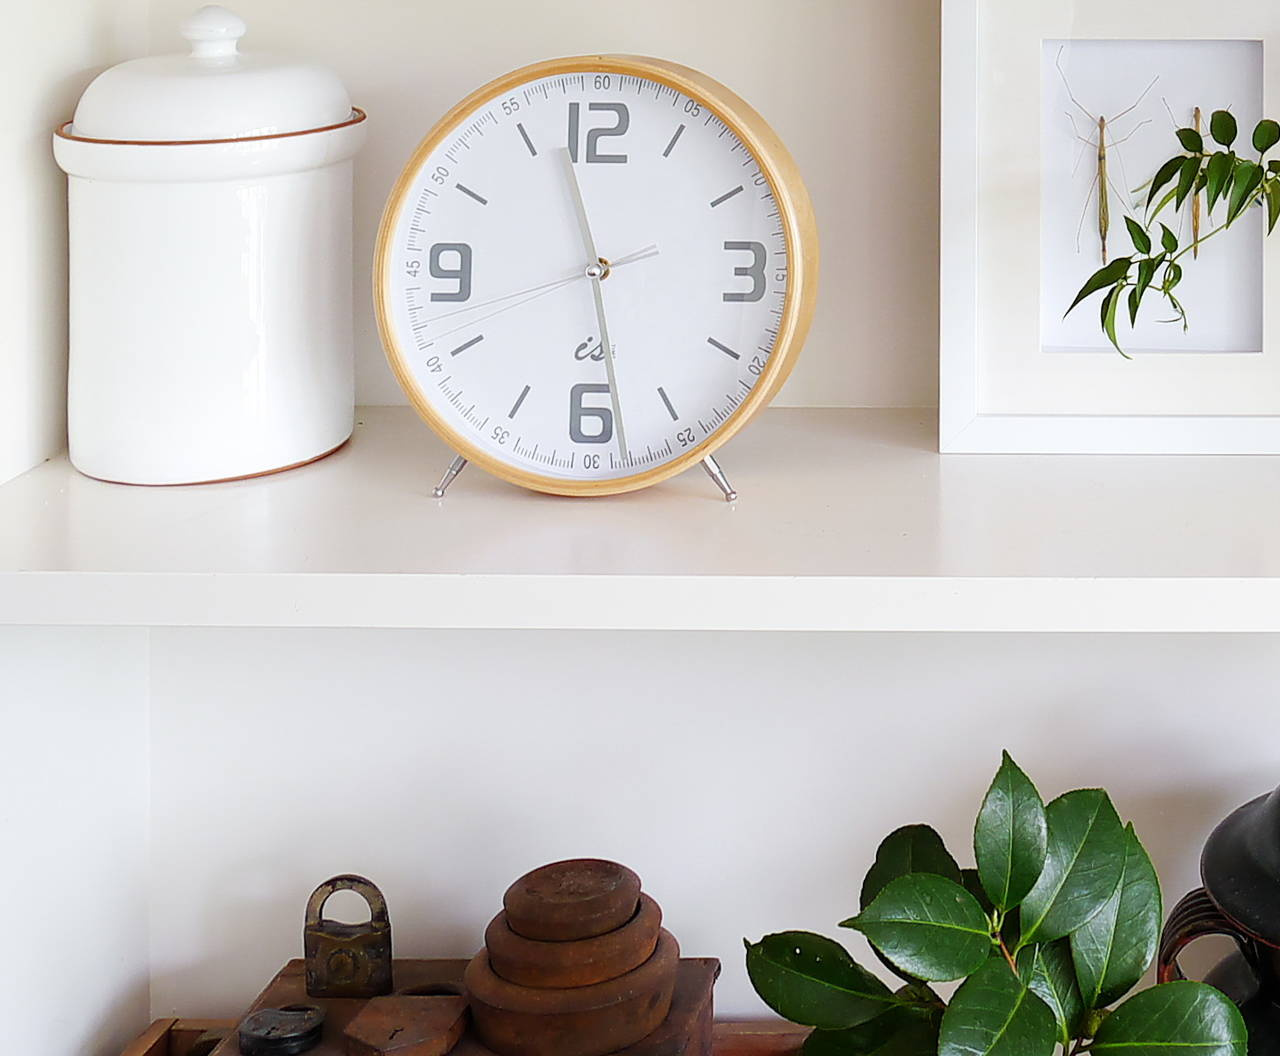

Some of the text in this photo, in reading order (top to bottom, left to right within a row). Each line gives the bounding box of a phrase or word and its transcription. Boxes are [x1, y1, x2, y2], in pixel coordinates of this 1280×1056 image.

[593, 75, 611, 90] 60
[501, 97, 521, 116] 55
[683, 98, 702, 118] 05
[567, 101, 630, 164] 12
[431, 165, 450, 186] 50
[406, 259, 421, 279] 45
[429, 242, 472, 303] 9
[722, 240, 767, 303] 3
[425, 355, 444, 375] 40
[569, 382, 614, 444] 6
[491, 425, 511, 445] 35
[676, 427, 696, 448] 25
[582, 454, 600, 470] 30
